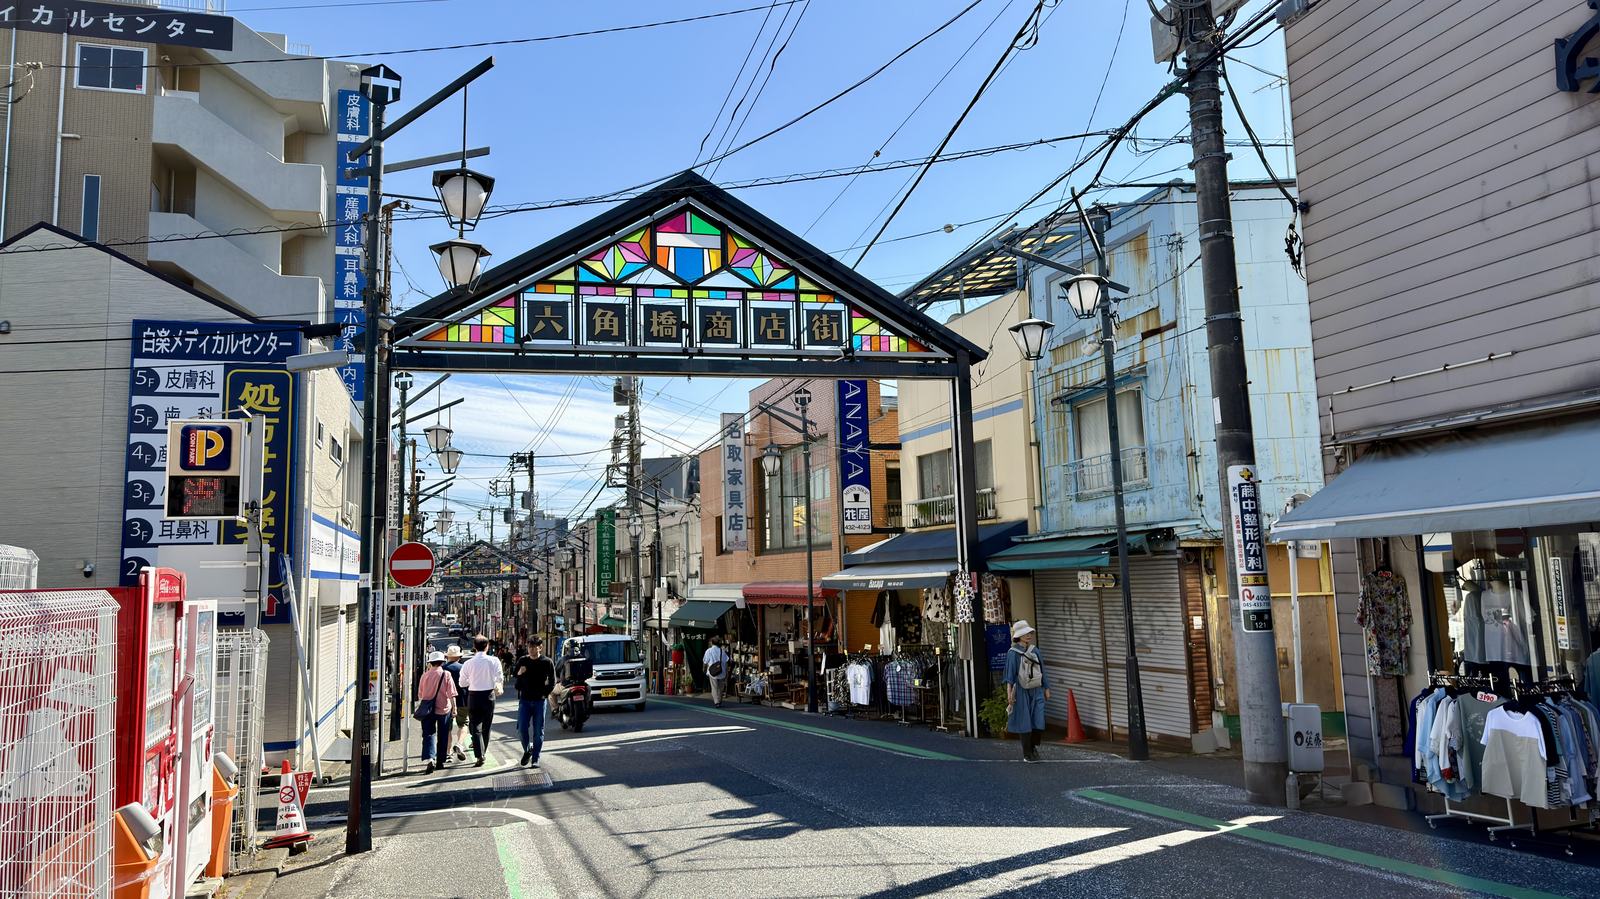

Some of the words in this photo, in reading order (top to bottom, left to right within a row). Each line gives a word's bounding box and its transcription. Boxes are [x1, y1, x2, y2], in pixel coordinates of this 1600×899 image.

[346, 94, 360, 131] 皮膚科
[344, 197, 359, 245] 産婦人科
[344, 259, 358, 297] 耳鼻科
[533, 305, 838, 342] 六角橋商店街
[143, 327, 292, 356] 白楽メディカルセンター
[135, 370, 155, 388] 5F
[165, 369, 216, 390] 皮膚科
[342, 366, 357, 397] 内科
[133, 408, 153, 426] 5F
[131, 445, 152, 465] 4F
[726, 421, 744, 532] 名取家具店
[132, 479, 151, 503] 3F
[845, 508, 870, 520] 花屋
[130, 521, 149, 541] 3F
[158, 520, 210, 539] 耳鼻科
[1240, 484, 1263, 571] 藤中整形外科
